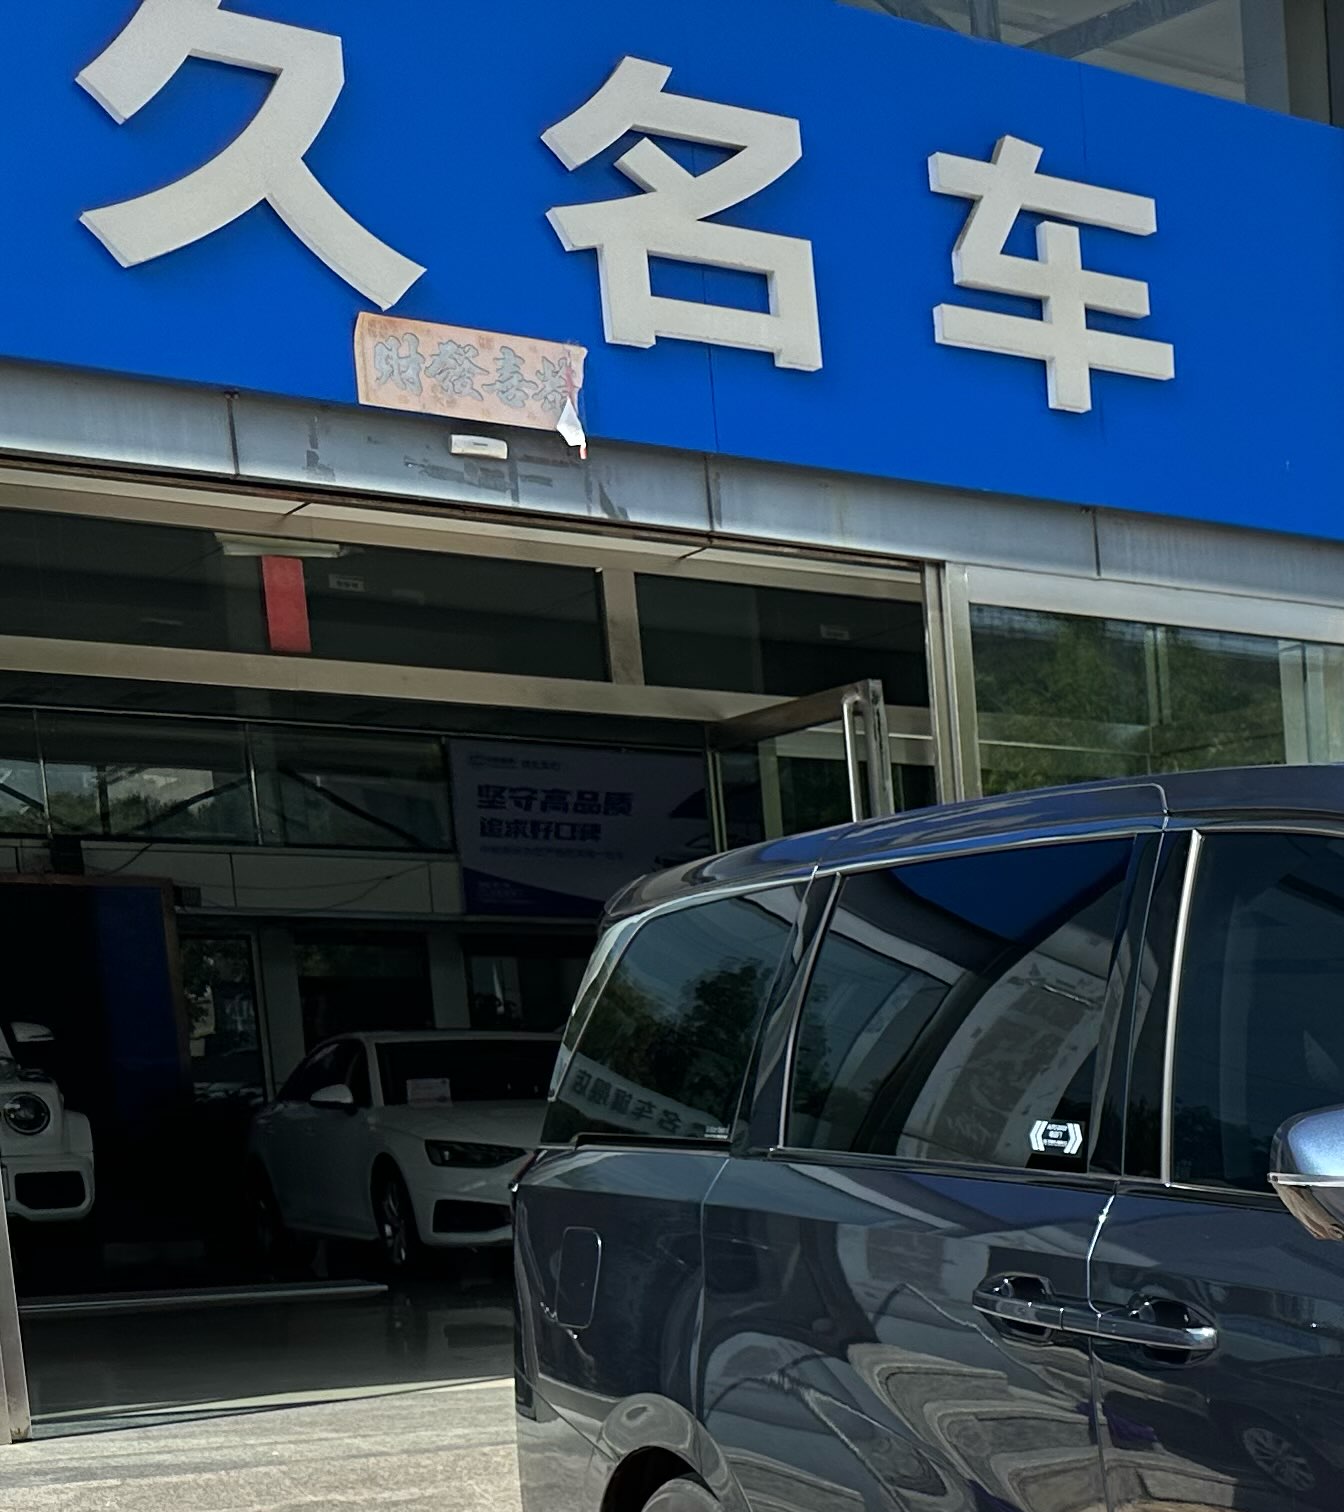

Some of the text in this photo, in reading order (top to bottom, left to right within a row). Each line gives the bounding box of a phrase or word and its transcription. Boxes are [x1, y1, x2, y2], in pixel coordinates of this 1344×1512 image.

[75, 0, 1175, 414] 久名车
[476, 783, 635, 817] 坚守高品质
